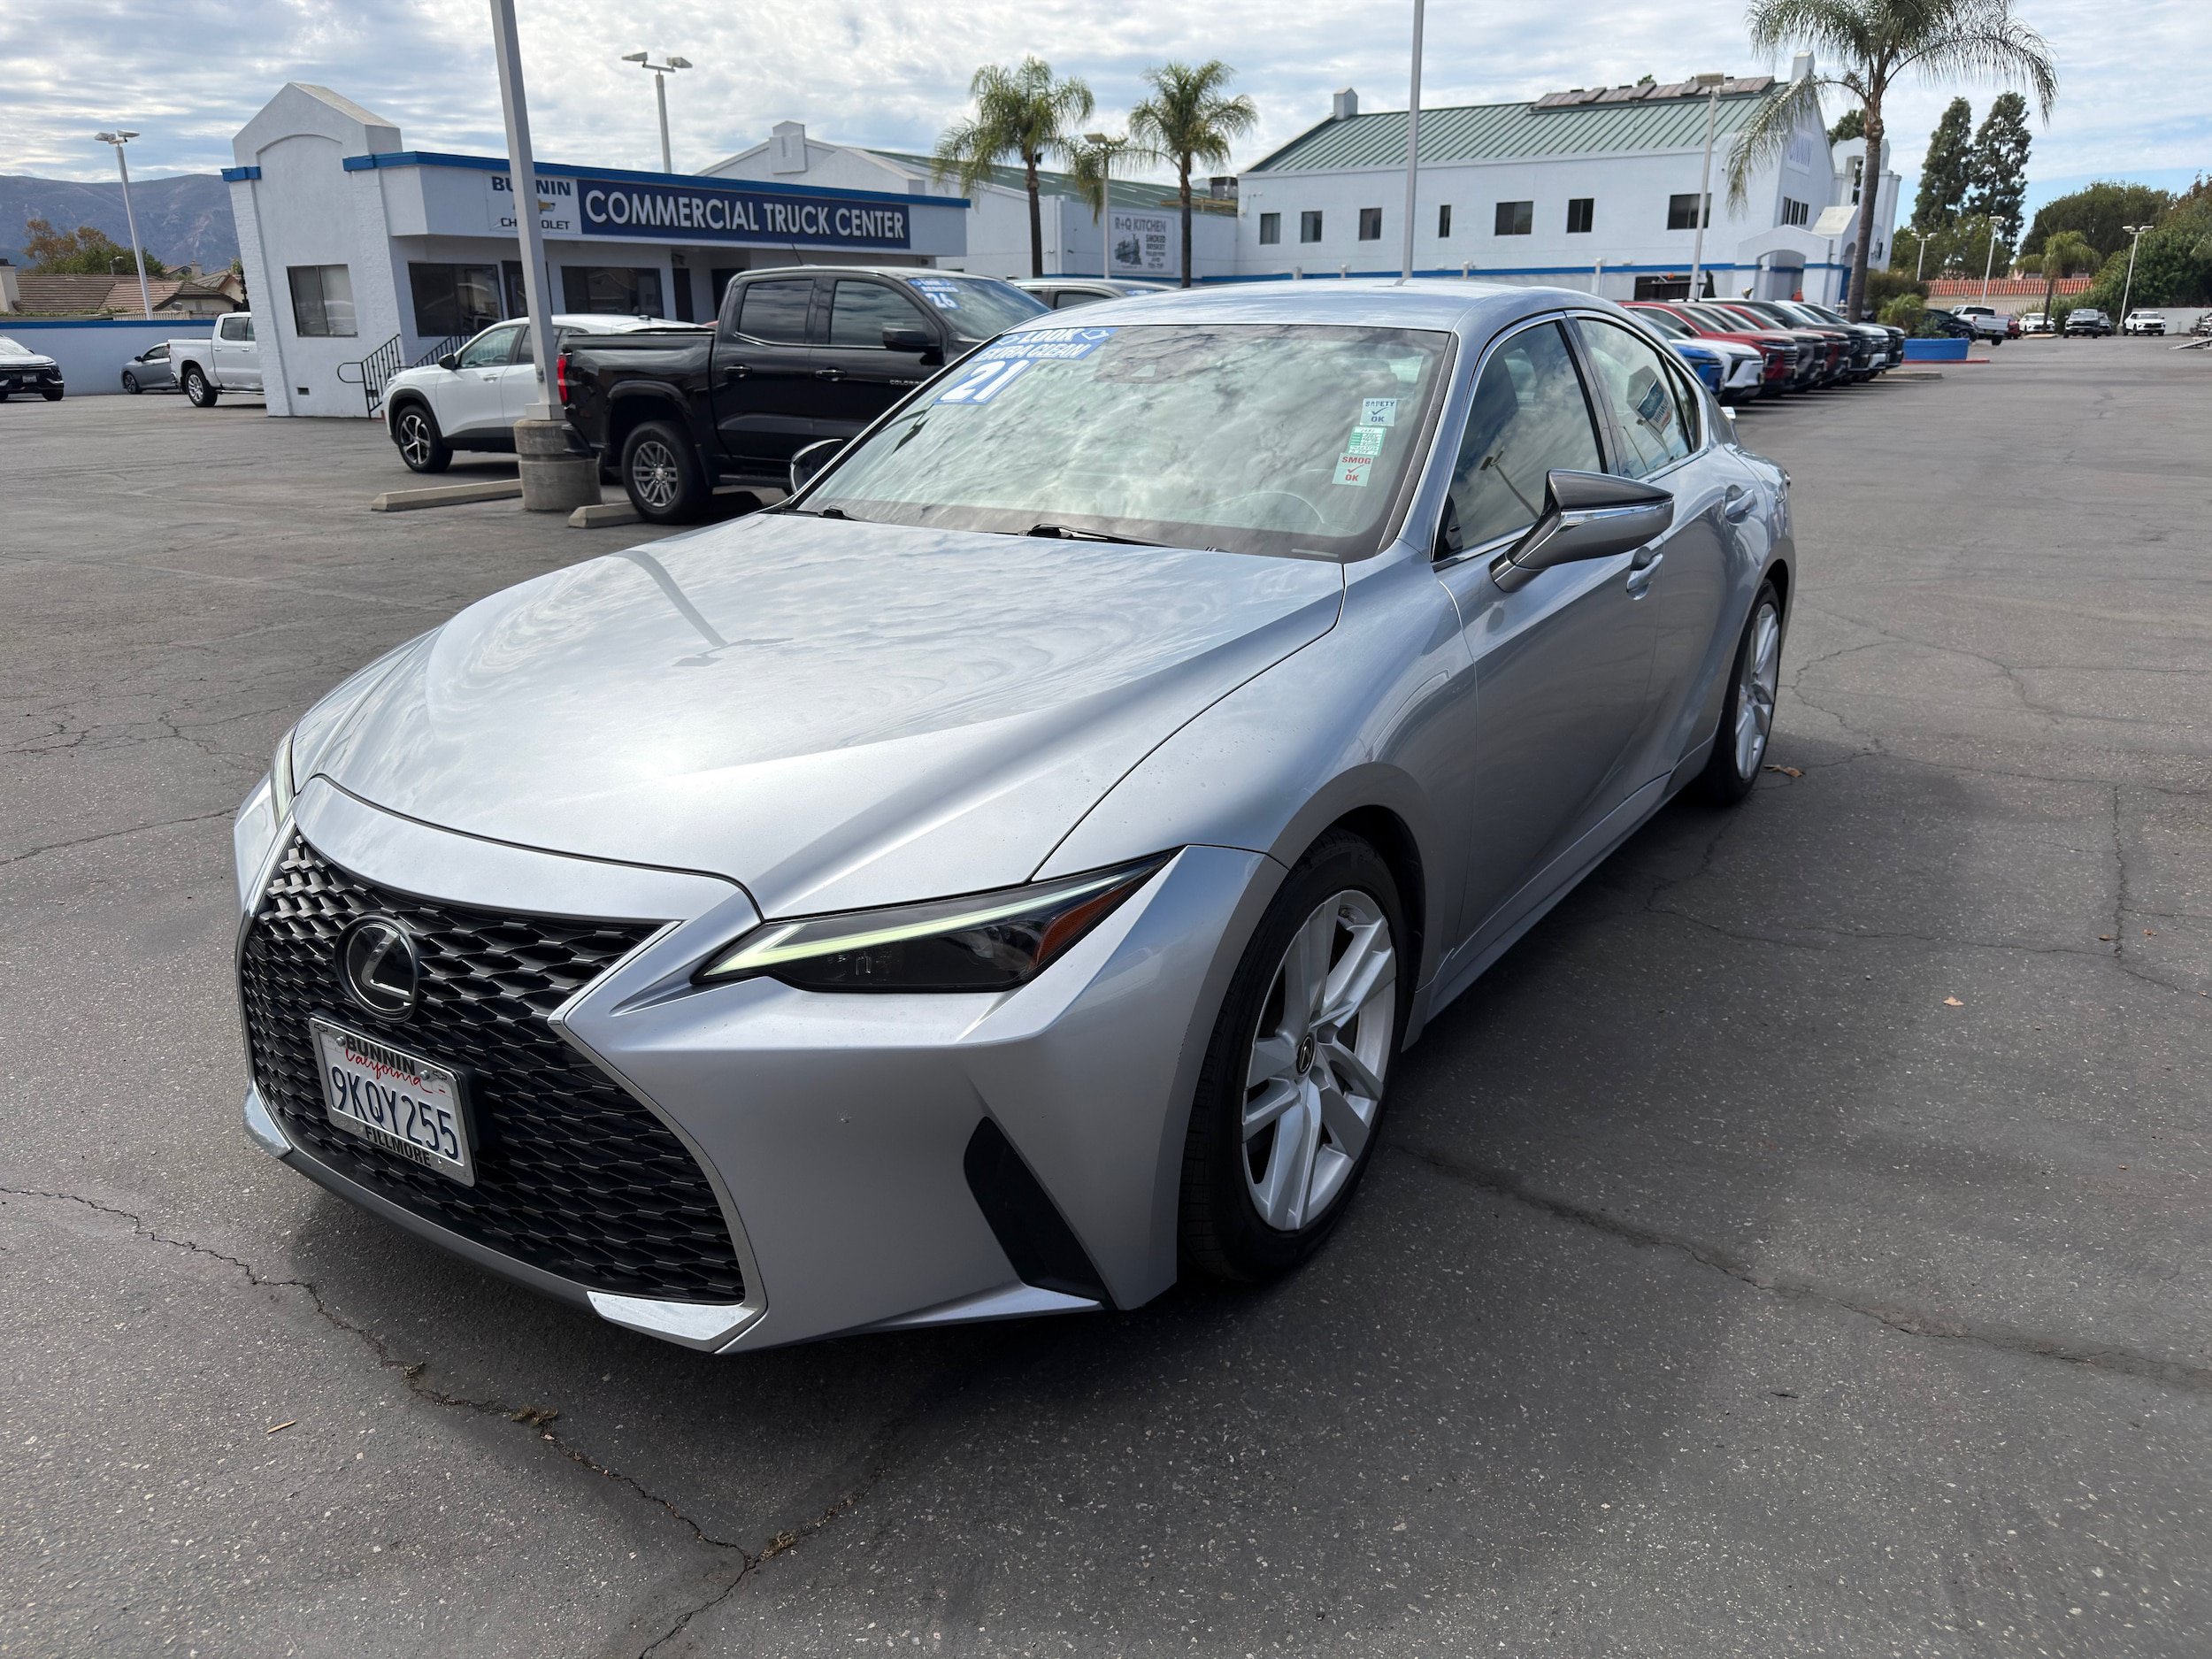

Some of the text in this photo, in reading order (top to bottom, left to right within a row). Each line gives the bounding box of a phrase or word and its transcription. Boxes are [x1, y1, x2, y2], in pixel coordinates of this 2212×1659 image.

[492, 176, 571, 196] BUNIN
[501, 218, 570, 229] CHOLET
[585, 189, 904, 238] COMMERCIAL TRUCK CENTER
[1133, 219, 1166, 232] KITCHEN
[925, 293, 956, 308] 26
[1018, 328, 1085, 344] LOOK
[973, 342, 1092, 363] EXTRA CLEAN
[940, 359, 1030, 403] 21
[346, 1033, 416, 1076] BUNNIN
[331, 1066, 458, 1160] 9KQY255
[365, 1125, 432, 1168] FILLMORE
